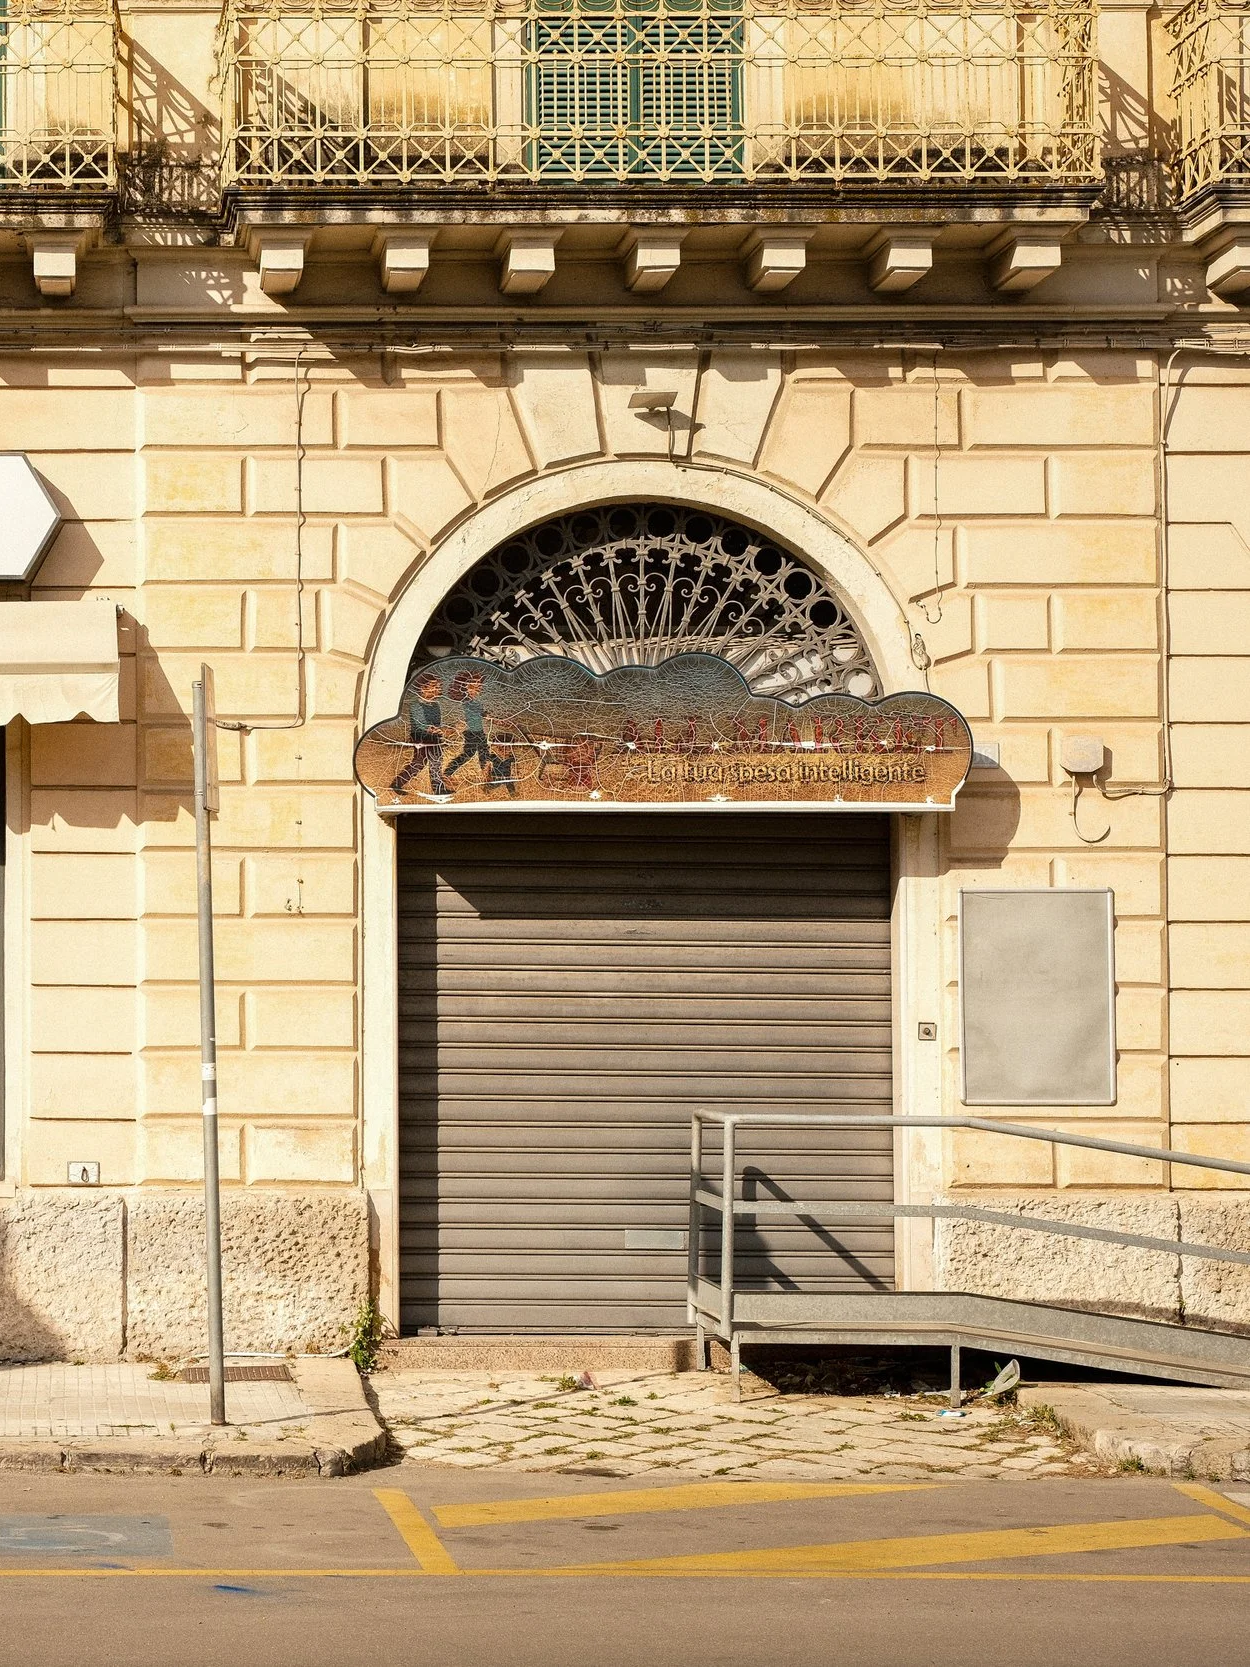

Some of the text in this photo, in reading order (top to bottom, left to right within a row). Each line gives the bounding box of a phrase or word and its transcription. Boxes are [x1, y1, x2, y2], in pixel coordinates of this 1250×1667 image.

[646, 760, 926, 786] La tua spesa intelligente
